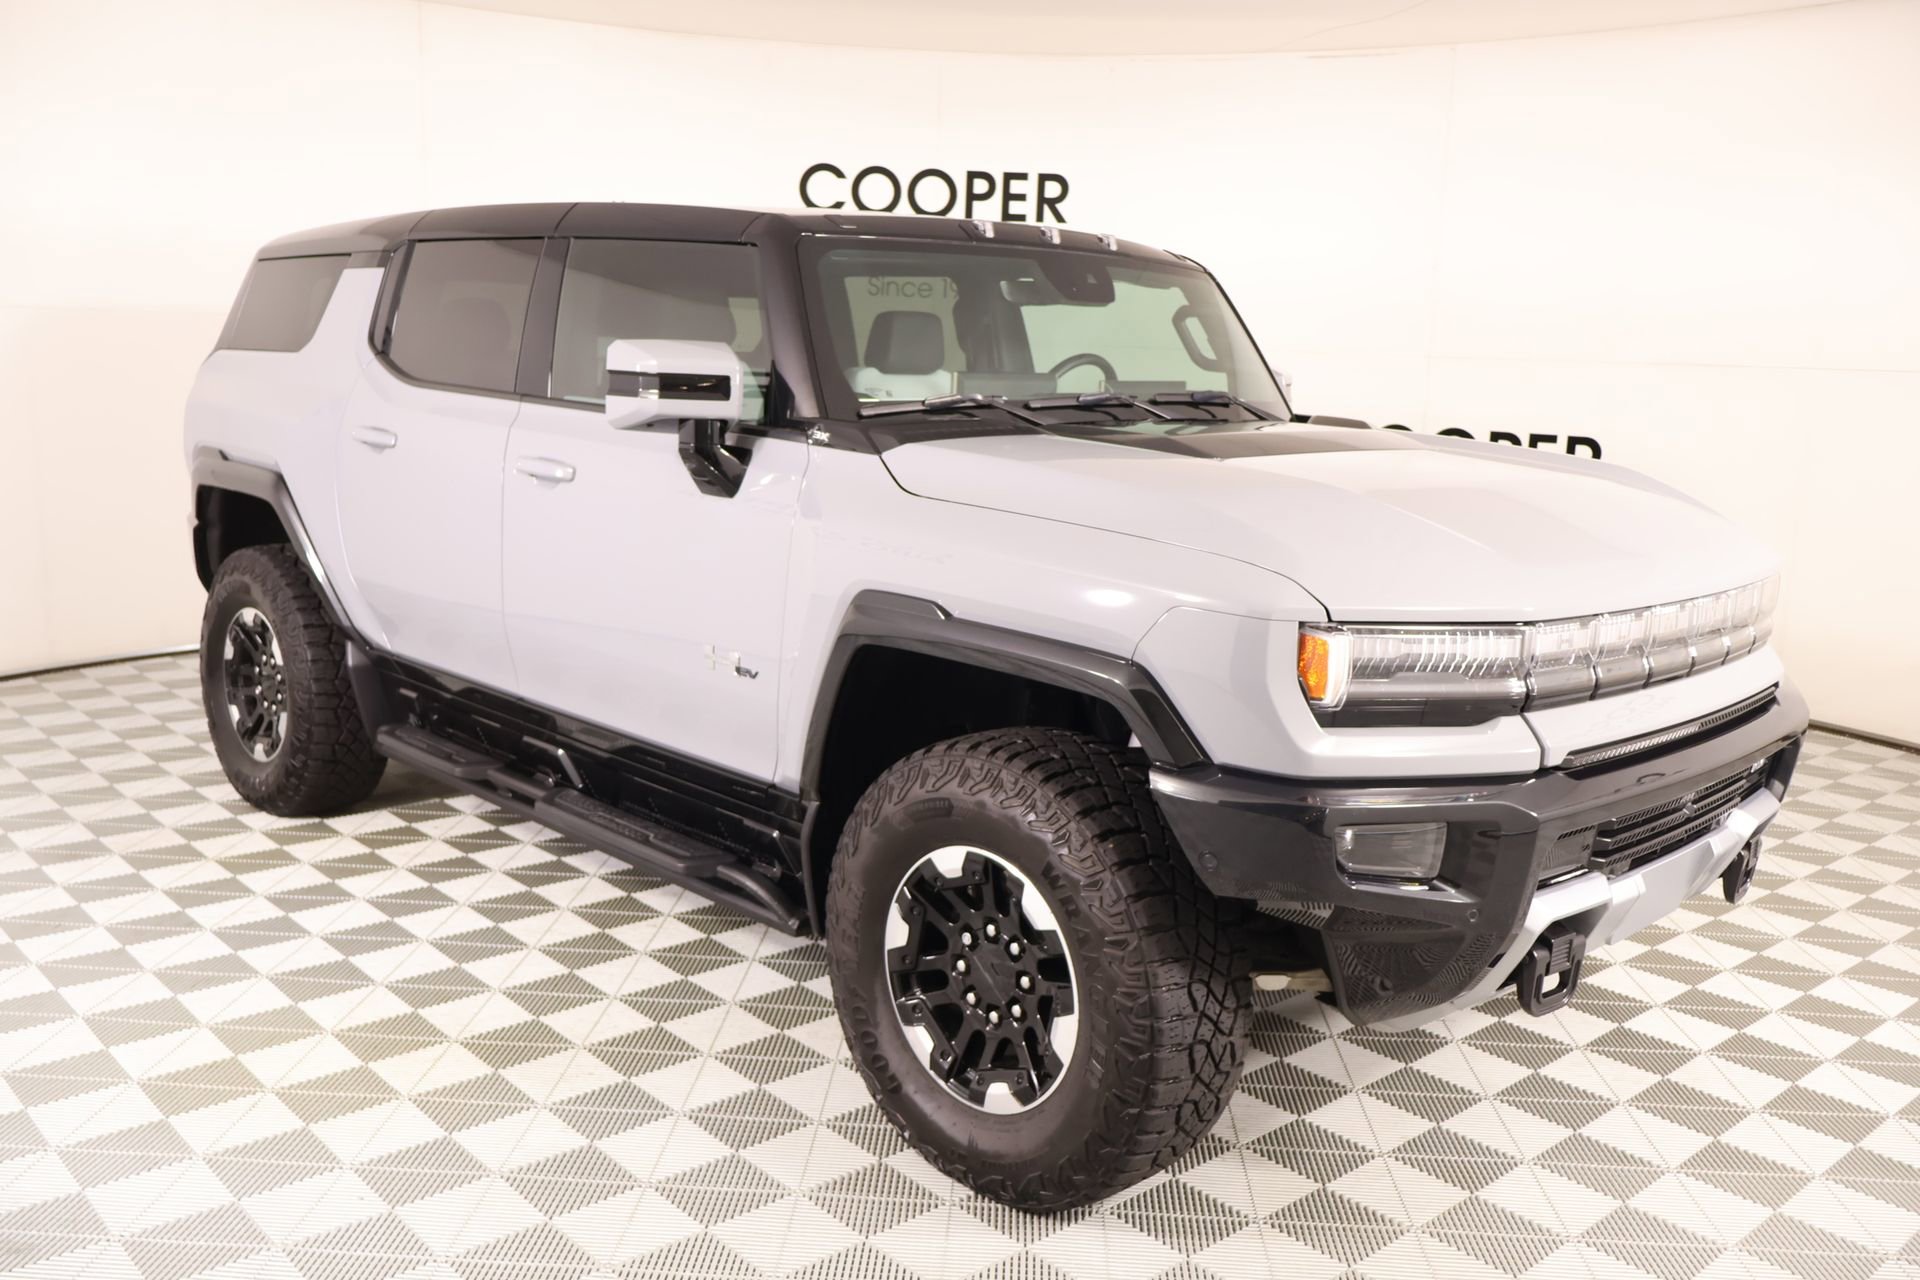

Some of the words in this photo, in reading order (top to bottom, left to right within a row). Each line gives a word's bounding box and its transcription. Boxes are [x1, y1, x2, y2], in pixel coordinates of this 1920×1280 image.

[799, 163, 1069, 223] COOPER
[867, 276, 933, 298] Since
[1041, 860, 1110, 1089] WRANGLER
